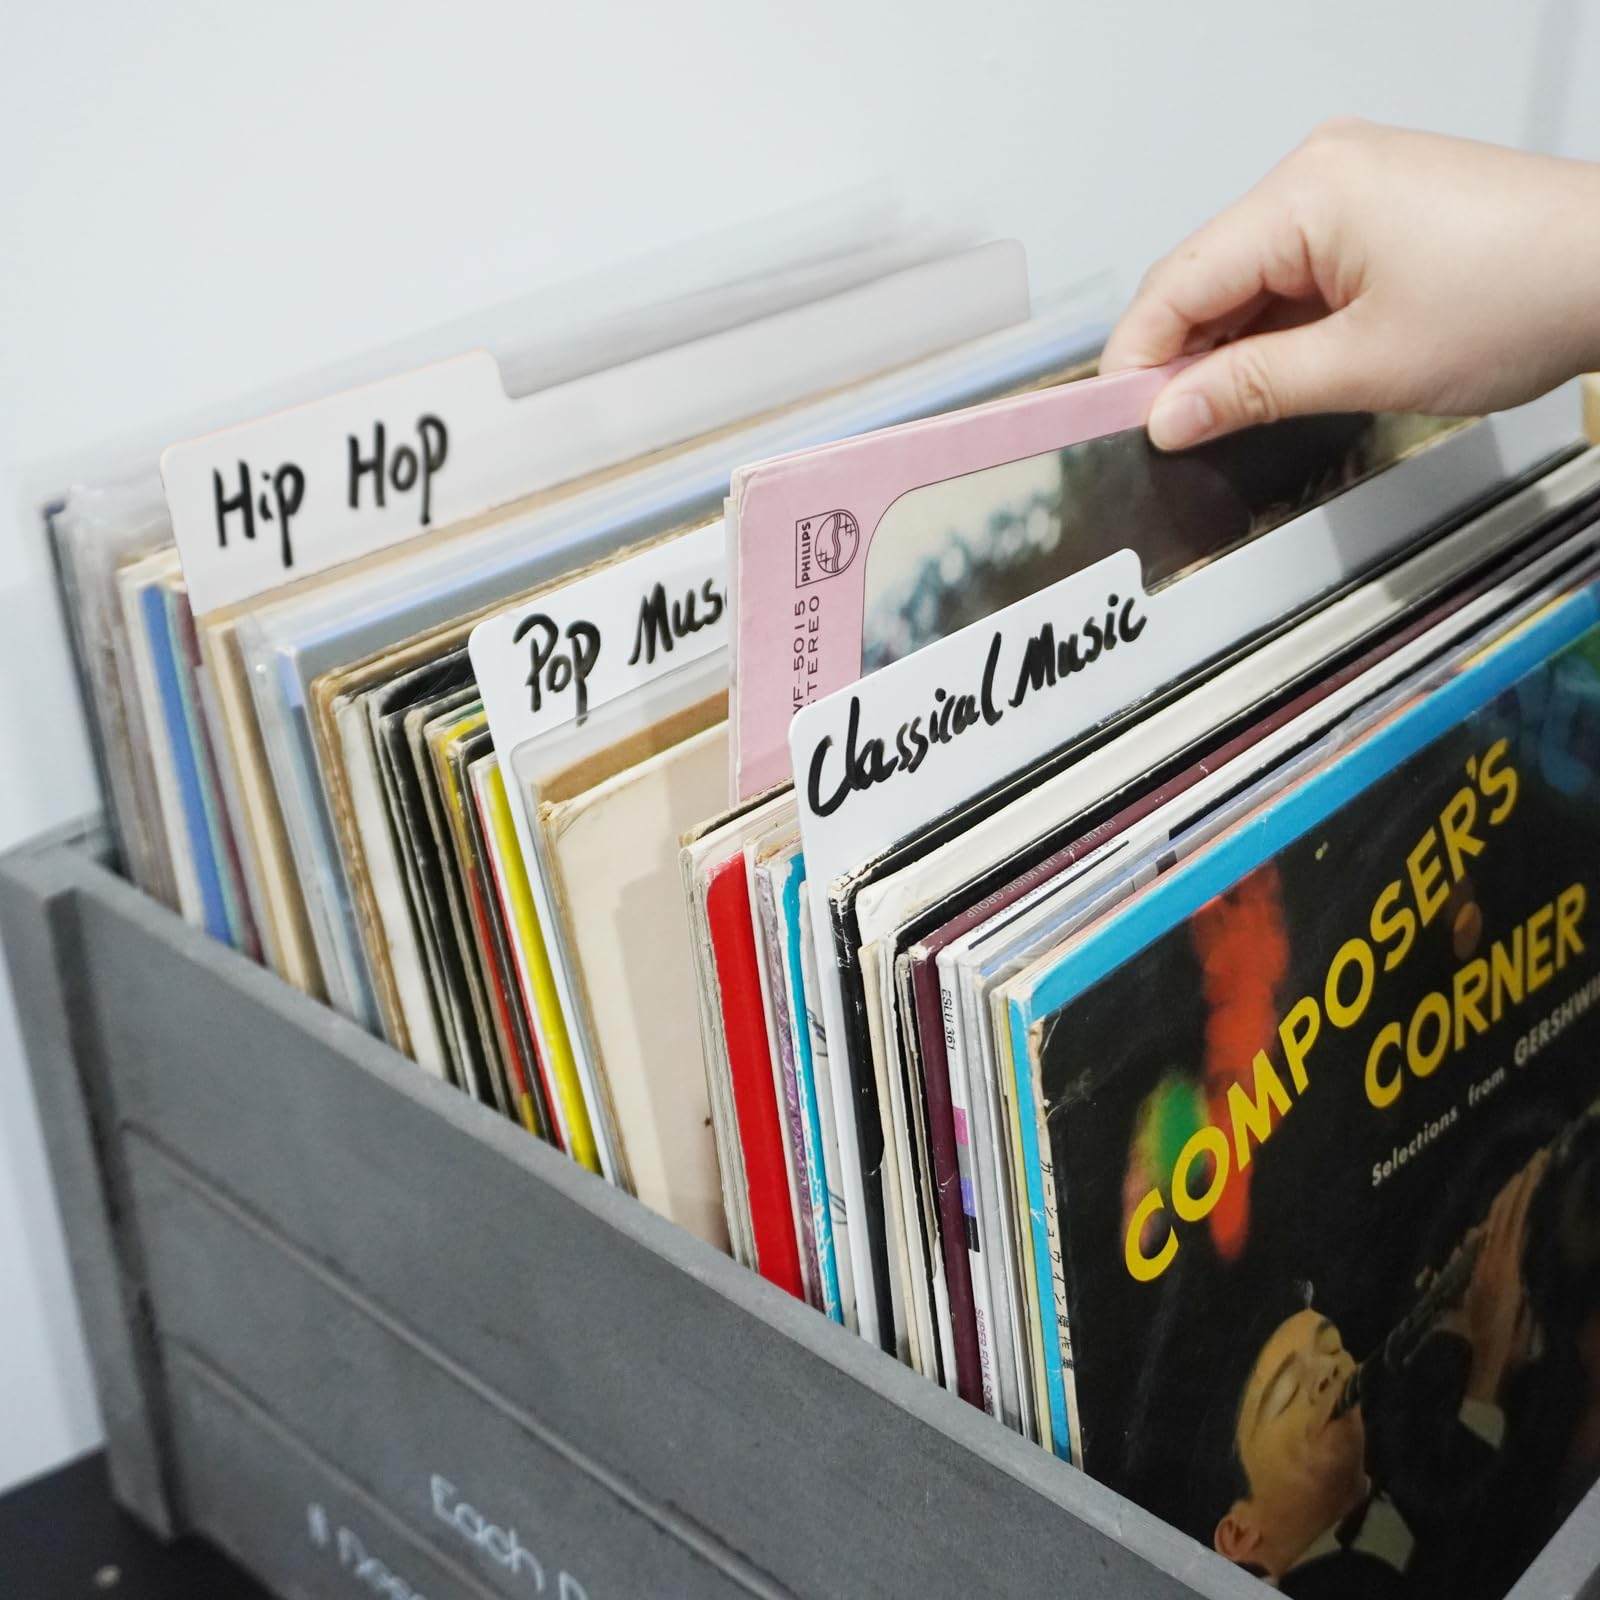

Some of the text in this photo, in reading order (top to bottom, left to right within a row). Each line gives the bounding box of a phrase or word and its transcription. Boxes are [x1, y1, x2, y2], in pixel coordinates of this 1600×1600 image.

[213, 414, 448, 569] Hip Hop
[801, 521, 811, 582] PHILIPS
[512, 577, 728, 727] Pop Mus
[807, 595, 820, 705] TEREO
[807, 593, 1147, 818] Classical Music
[1040, 856, 1057, 872] JAM
[1081, 820, 1115, 844] ISLAND
[966, 890, 1004, 918] GROUP
[1008, 870, 1039, 893] MUSIC
[942, 988, 957, 1051] ESLU 361
[1124, 738, 1520, 1282] COMPOSER'S
[1364, 883, 1587, 1109] CORNER
[1371, 972, 1600, 1188] Selections from GERSHWI
[976, 1309, 988, 1347] SUPER
